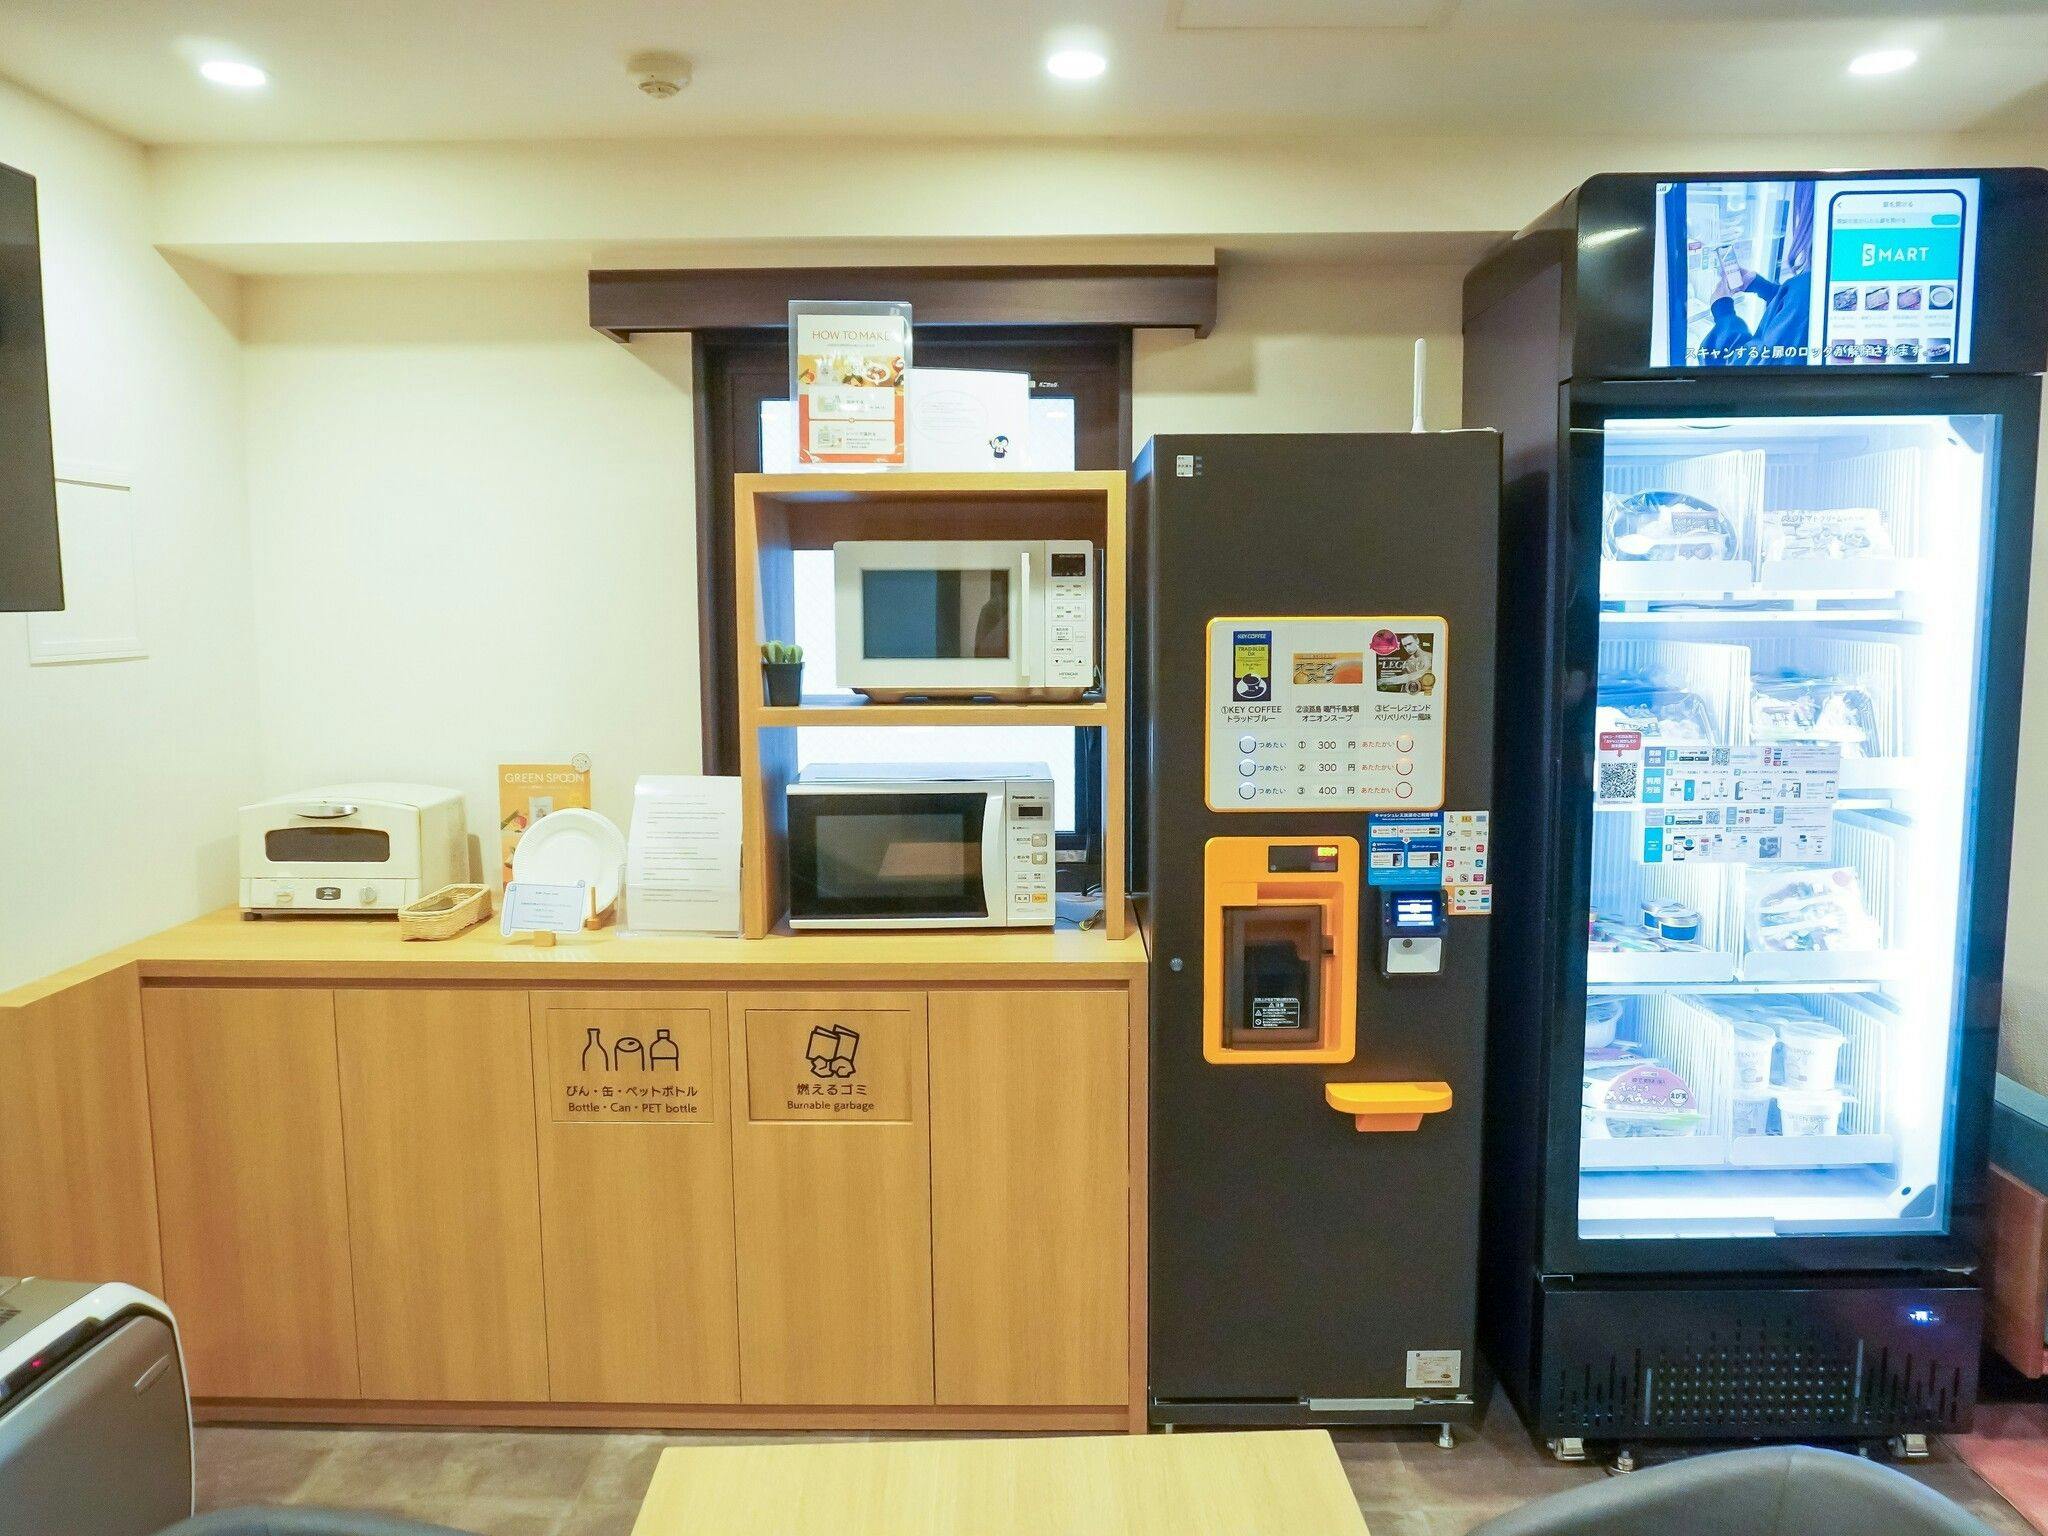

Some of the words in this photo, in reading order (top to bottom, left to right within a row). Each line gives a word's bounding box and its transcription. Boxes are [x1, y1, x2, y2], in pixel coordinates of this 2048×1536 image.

[1862, 243, 1930, 267] SMART
[812, 330, 840, 341] HOW
[842, 330, 858, 341] TO
[1248, 705, 1282, 714] COFFEE
[1227, 714, 1276, 723] トラッドブルー
[1302, 714, 1354, 722] オニオンスープ
[1318, 740, 1337, 750] 300
[1348, 741, 1356, 750] 円
[1318, 763, 1337, 772] 300
[1348, 764, 1356, 772] 円
[504, 772, 544, 783] GREEN
[546, 772, 584, 783] SPOON
[1318, 786, 1337, 795] 400
[1347, 786, 1355, 795] 円
[566, 1085, 698, 1097] びん・缶・ペットボトル
[796, 1083, 868, 1096] 燃えるゴミ
[568, 1102, 600, 1112] Bottle
[610, 1102, 631, 1112] Can
[642, 1103, 662, 1113] PET
[665, 1102, 698, 1113] bottle
[787, 1100, 831, 1110] Burnable
[834, 1101, 875, 1112] garbage
